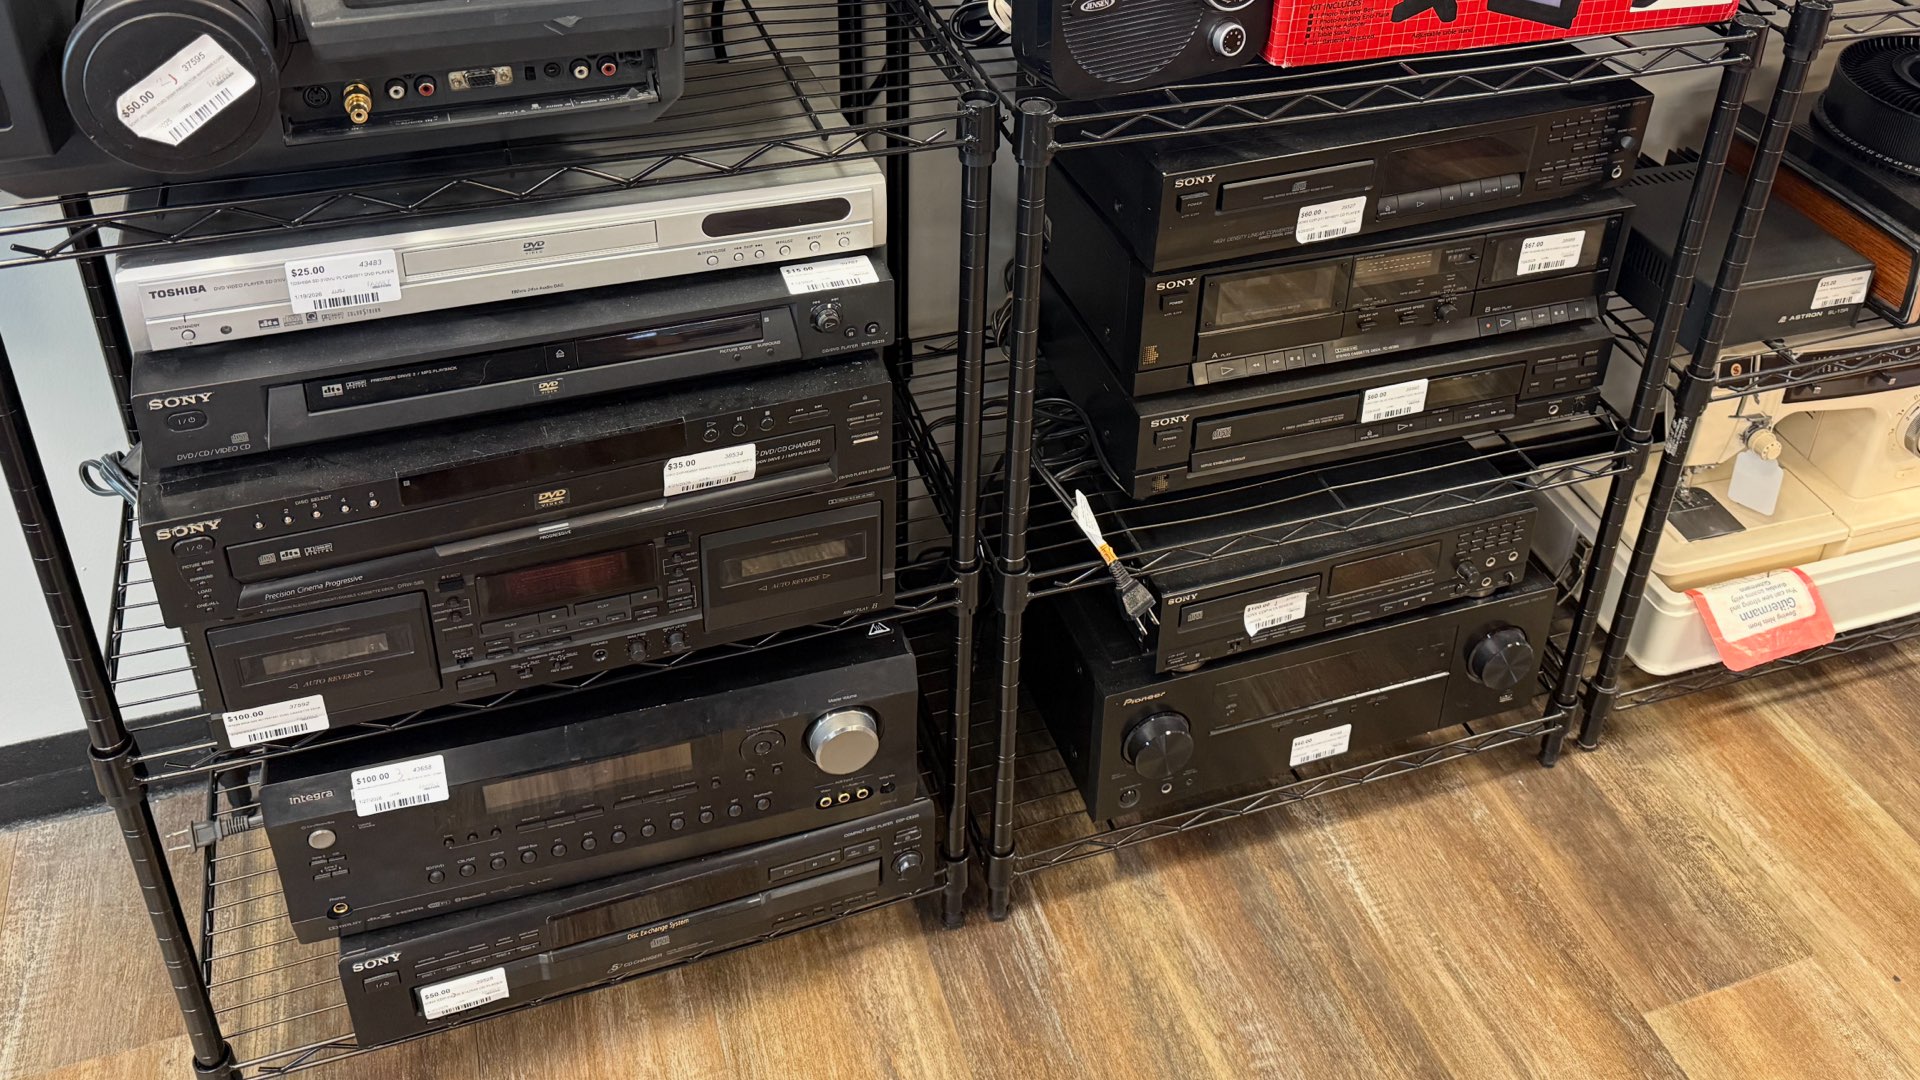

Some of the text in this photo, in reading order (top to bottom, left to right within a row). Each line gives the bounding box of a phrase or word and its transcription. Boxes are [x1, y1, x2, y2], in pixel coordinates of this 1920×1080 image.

[1310, 3, 1322, 11] KIT
[1340, 8, 1362, 16] Transfer
[1412, 30, 1442, 39] Adjustable
[180, 52, 206, 72] 37595
[122, 90, 155, 119] $50.00
[1174, 173, 1217, 189] SONY
[1300, 209, 1322, 219] $60.00
[1226, 233, 1248, 243] DENSITY
[1248, 230, 1265, 240] LINEAR
[523, 240, 545, 249] DVD
[1524, 241, 1544, 250] $67.00
[290, 265, 326, 278] $25.00
[1156, 277, 1197, 291] SONY
[148, 284, 207, 300] TOSHIBA
[1788, 311, 1824, 321] ASTRON
[322, 383, 344, 398] dts
[538, 380, 559, 389] DVD
[148, 391, 213, 412] SONY
[1150, 414, 1190, 428] SONY
[760, 438, 822, 458] DVD/CD CHANGER
[798, 447, 821, 457] PLAYBACK
[667, 459, 696, 471] $35.00
[538, 488, 567, 502] DVD
[540, 500, 564, 508] VIDEO
[156, 518, 223, 542] SONY
[279, 547, 302, 562] dts
[264, 574, 364, 602] Precision Cinema Progressive
[771, 575, 820, 590] AUTO REVERSE
[1167, 593, 1198, 606] SONY
[1762, 594, 1774, 602] sew
[1774, 590, 1785, 598] can
[1729, 604, 1742, 614] and
[1739, 596, 1797, 623] Gütermann
[1741, 597, 1762, 609] strong
[1776, 610, 1797, 620] Sewing
[1747, 620, 1762, 630] from
[302, 670, 363, 688] AUTO REVERSE
[827, 693, 858, 704] Master Volume
[1123, 691, 1166, 707] Pioneer
[226, 710, 264, 723] $100.00
[288, 788, 334, 806] Integra
[627, 930, 639, 940] Disc
[669, 917, 690, 929] System
[352, 951, 402, 973] SONY
[424, 988, 451, 1001] $50.00
